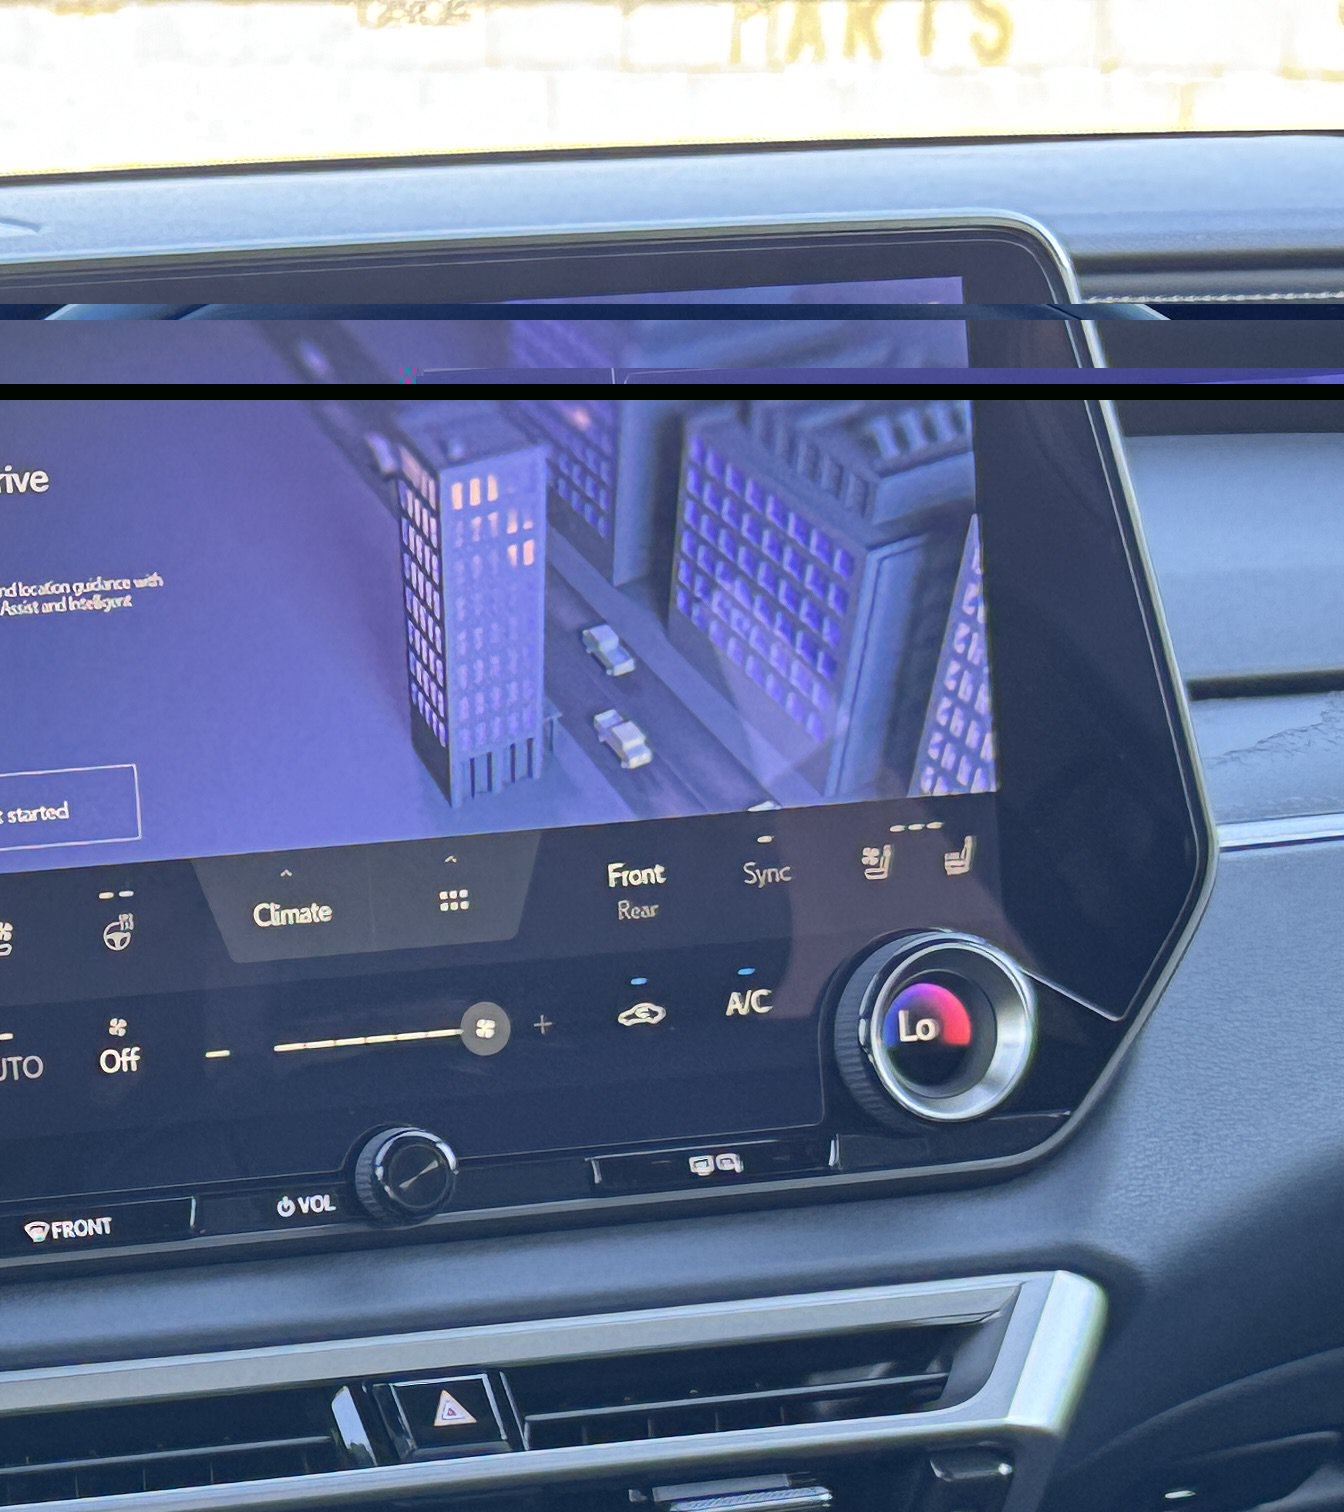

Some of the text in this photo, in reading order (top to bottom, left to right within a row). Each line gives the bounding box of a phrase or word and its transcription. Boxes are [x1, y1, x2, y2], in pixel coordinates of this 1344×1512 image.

[18, 579, 70, 597] location
[72, 576, 131, 596] guidance
[133, 572, 164, 589] with
[0, 599, 39, 618] Assist
[41, 596, 66, 613] and
[68, 591, 133, 613] Intelligent
[6, 801, 70, 825] started
[607, 861, 667, 889] Front
[743, 861, 793, 890] Sync
[253, 901, 333, 928] Climate
[618, 900, 659, 921] Rear
[726, 988, 774, 1017] A/C
[898, 1010, 939, 1042] Lo
[99, 1046, 142, 1075] Off
[297, 1193, 336, 1214] VOL
[51, 1216, 113, 1240] FRONT
